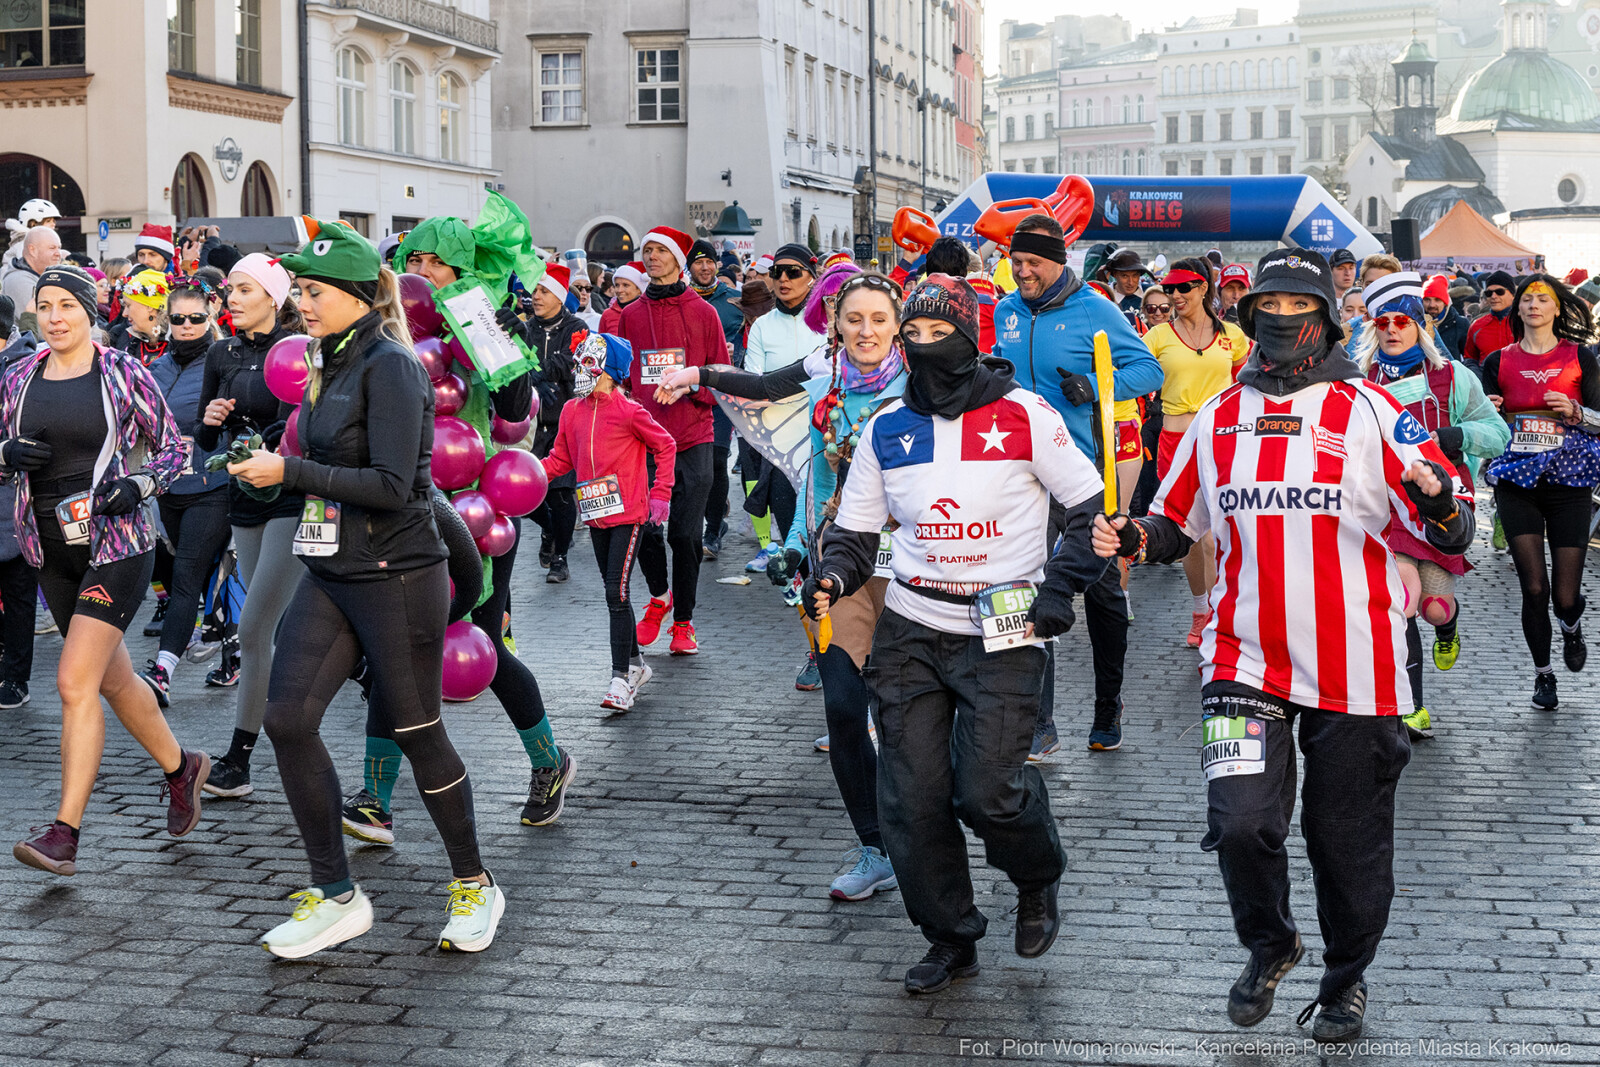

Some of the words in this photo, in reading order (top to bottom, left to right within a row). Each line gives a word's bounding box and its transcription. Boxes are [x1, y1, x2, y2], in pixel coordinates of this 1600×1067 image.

[1129, 191, 1183, 200] KRAKOWSKI
[689, 204, 704, 212] BAR
[689, 211, 719, 220] SZARA
[1129, 201, 1183, 220] BIEG
[648, 353, 675, 366] 3226
[1256, 418, 1300, 433] Orange
[1523, 419, 1556, 434] 3035
[1517, 433, 1559, 445] KATARZYNA
[581, 483, 608, 499] 3060
[580, 495, 617, 511] MARCELINA
[1219, 487, 1342, 513] COMARCH
[914, 524, 961, 539] ORLEN
[966, 519, 1004, 540] OIL
[939, 553, 988, 563] PLATINUM
[1203, 741, 1241, 765] MONIKA
